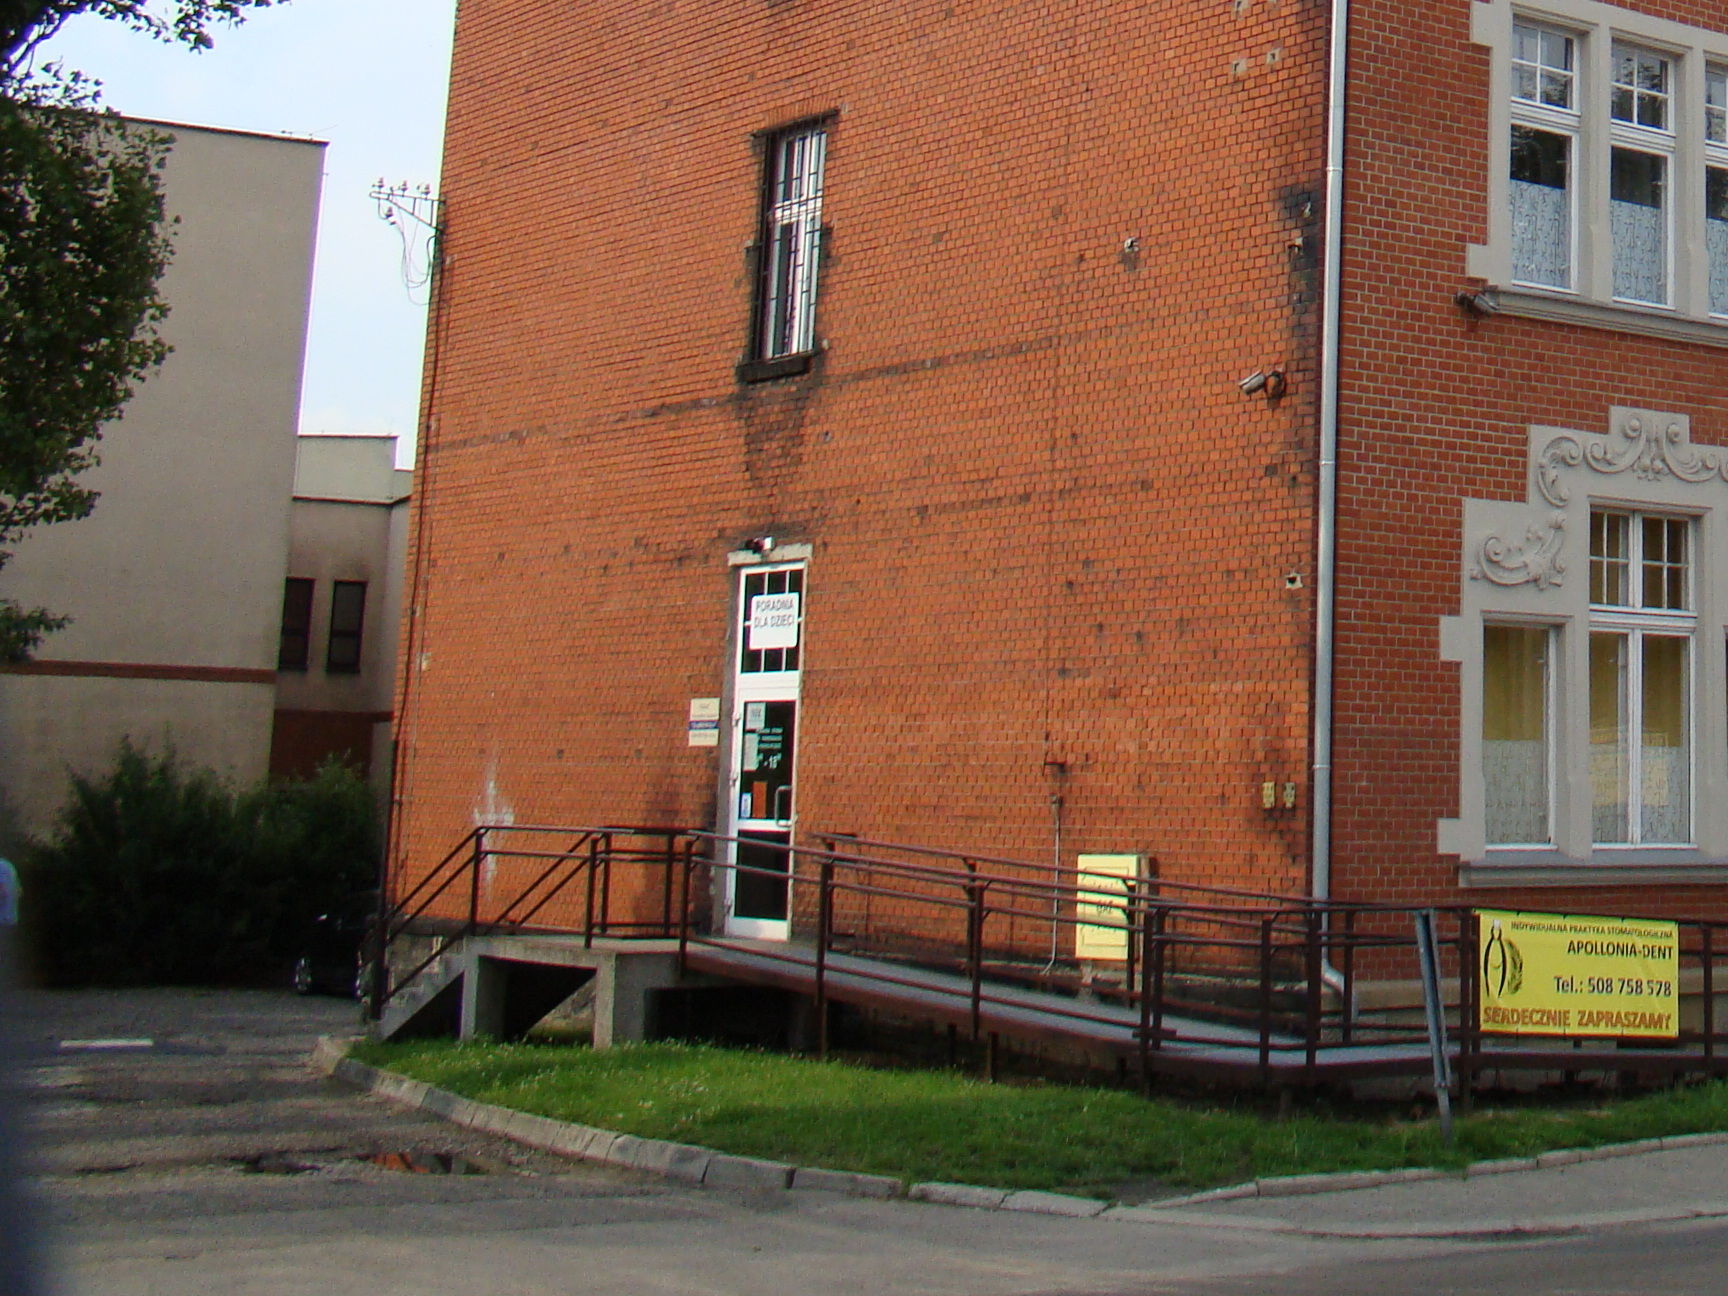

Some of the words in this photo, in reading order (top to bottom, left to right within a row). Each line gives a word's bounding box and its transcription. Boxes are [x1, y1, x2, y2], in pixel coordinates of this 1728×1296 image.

[1511, 921, 1568, 933] INDYWIDUALNA
[1569, 924, 1606, 935] PRAKTYKA
[1607, 926, 1673, 939] STOMATOLOGICZNA
[1568, 940, 1674, 959] APOLLONIA-DENT
[1554, 975, 1583, 993] Tel.:
[1588, 977, 1614, 994] 508
[1618, 978, 1643, 995] 758
[1647, 979, 1672, 997] 578
[1483, 1006, 1571, 1027] SERDECZNIE
[1577, 1010, 1672, 1030] ZAPRASZAMY
